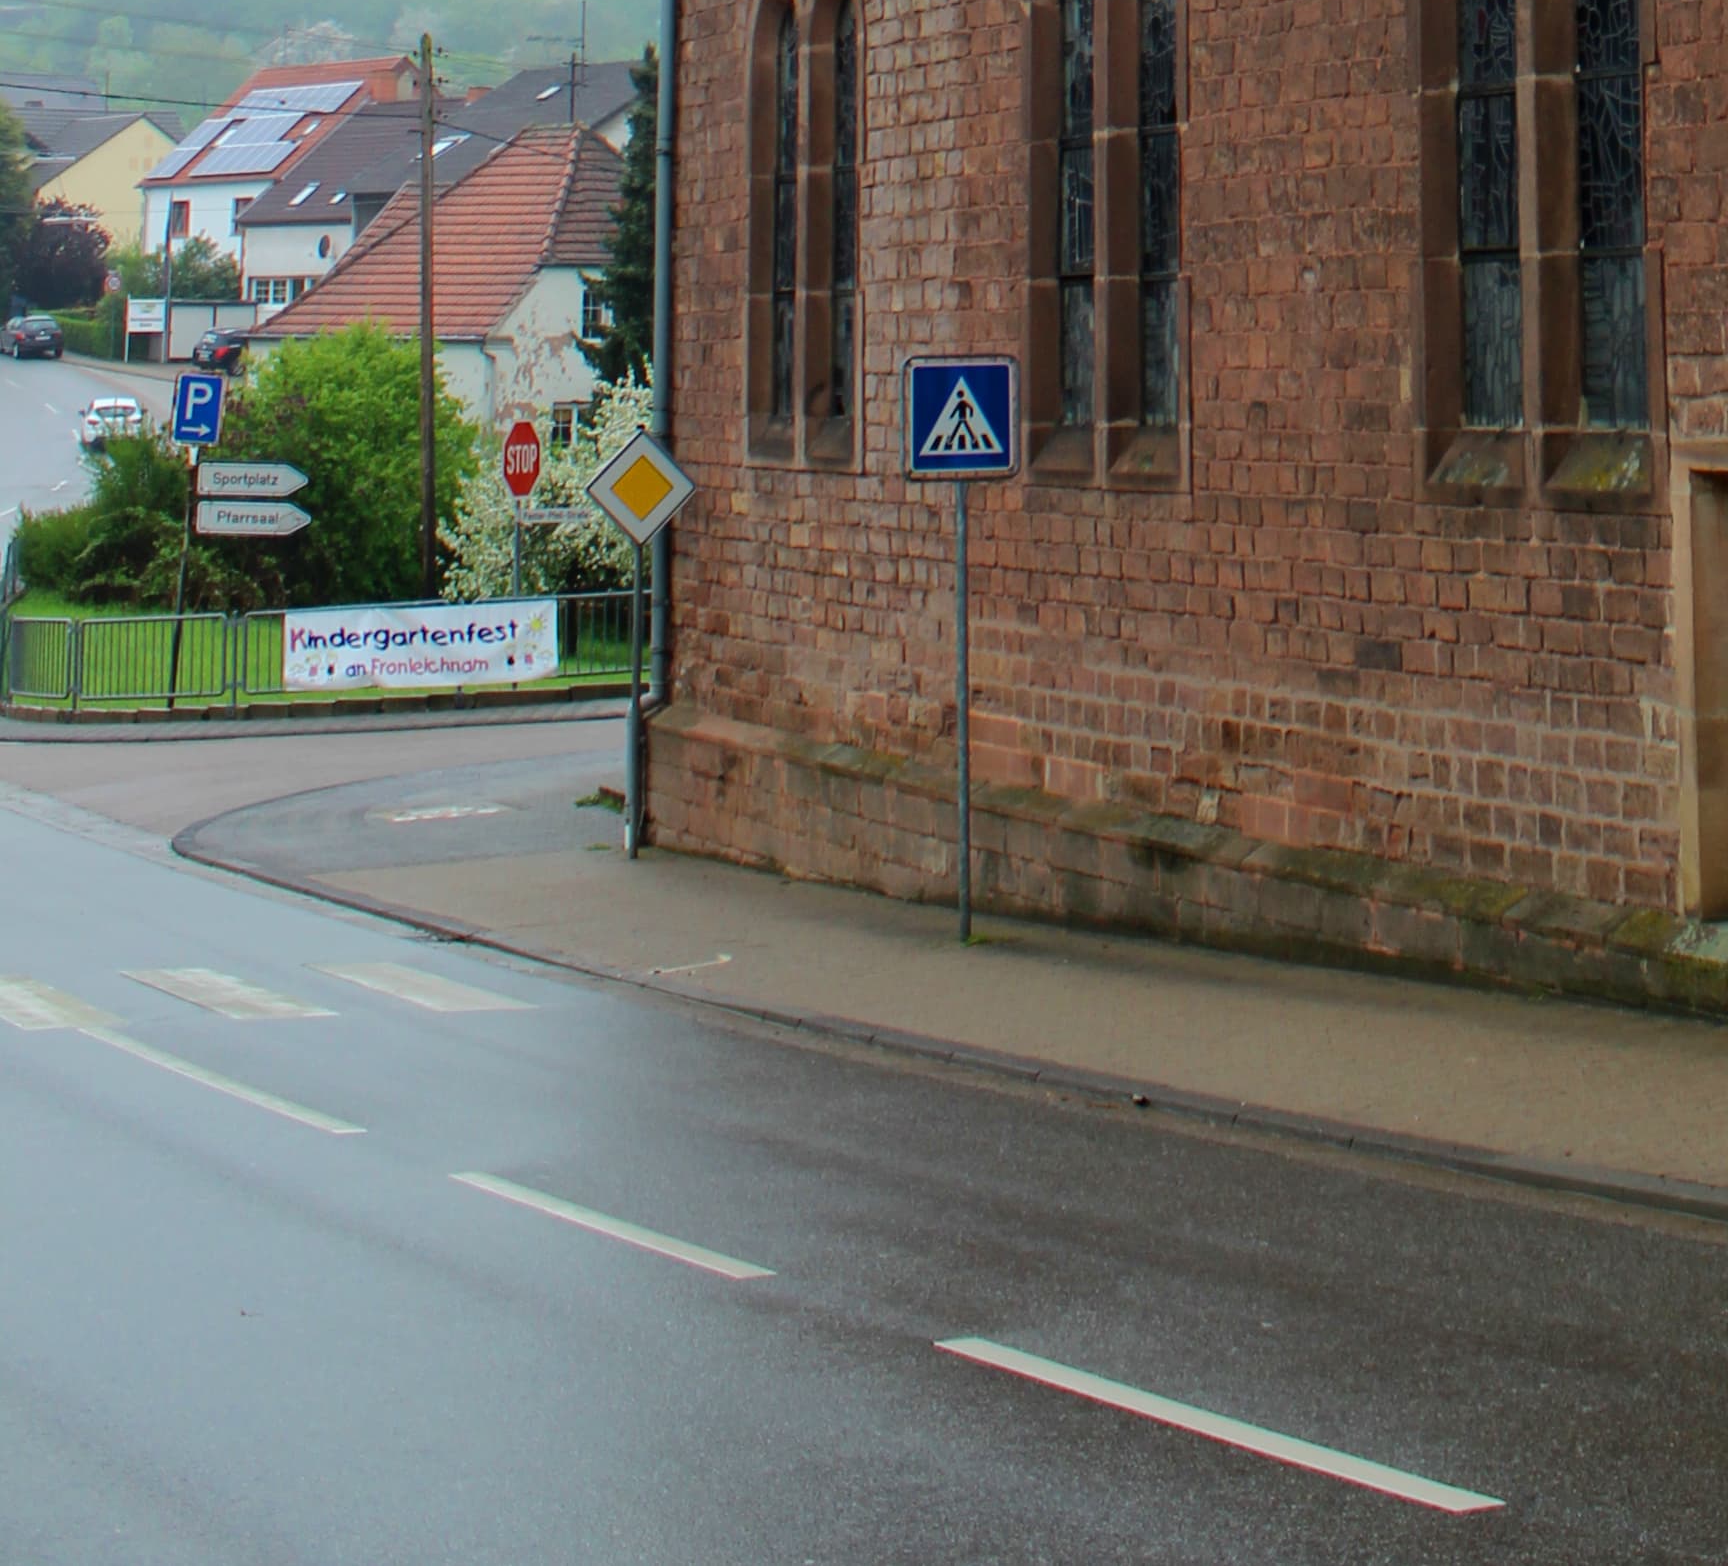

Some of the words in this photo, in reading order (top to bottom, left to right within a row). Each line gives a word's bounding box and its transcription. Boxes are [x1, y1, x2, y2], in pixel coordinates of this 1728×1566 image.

[185, 382, 213, 420] P
[506, 444, 538, 475] STOP
[213, 472, 279, 487] Sportplatz
[216, 510, 279, 524] Pfarrsaal
[291, 620, 519, 651] Kindergartenfest
[345, 661, 367, 677] an
[371, 657, 489, 676] Fronleichnam
